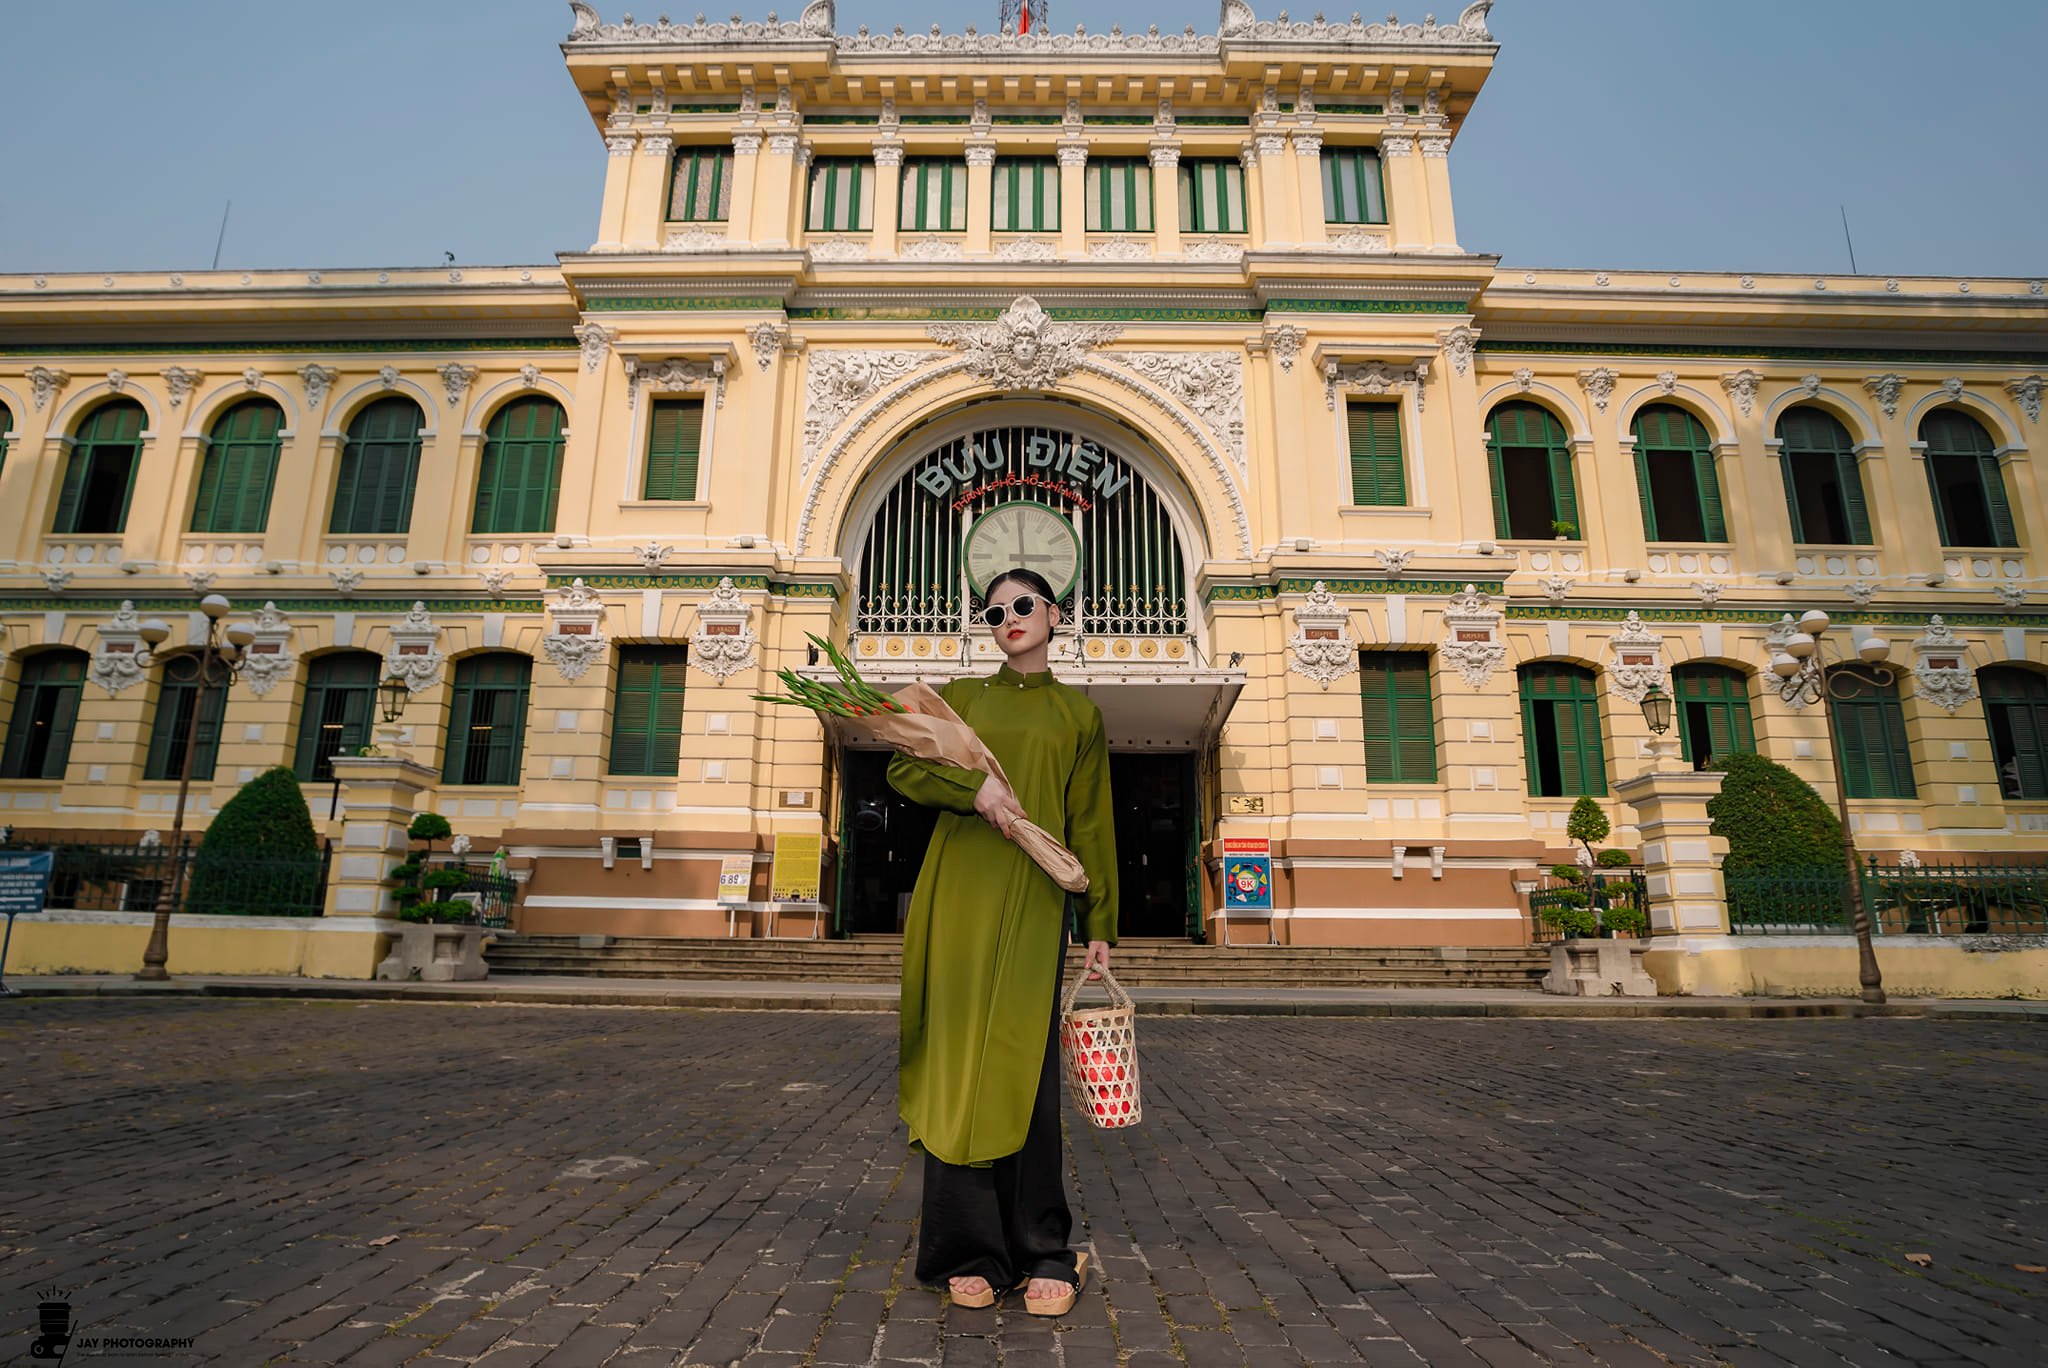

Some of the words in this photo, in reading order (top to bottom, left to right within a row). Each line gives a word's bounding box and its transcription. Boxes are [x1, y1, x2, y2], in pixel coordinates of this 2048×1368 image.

[1026, 436, 1130, 499] ĐIỆN
[1064, 487, 1093, 511] MINH
[1240, 880, 1253, 889] 9K
